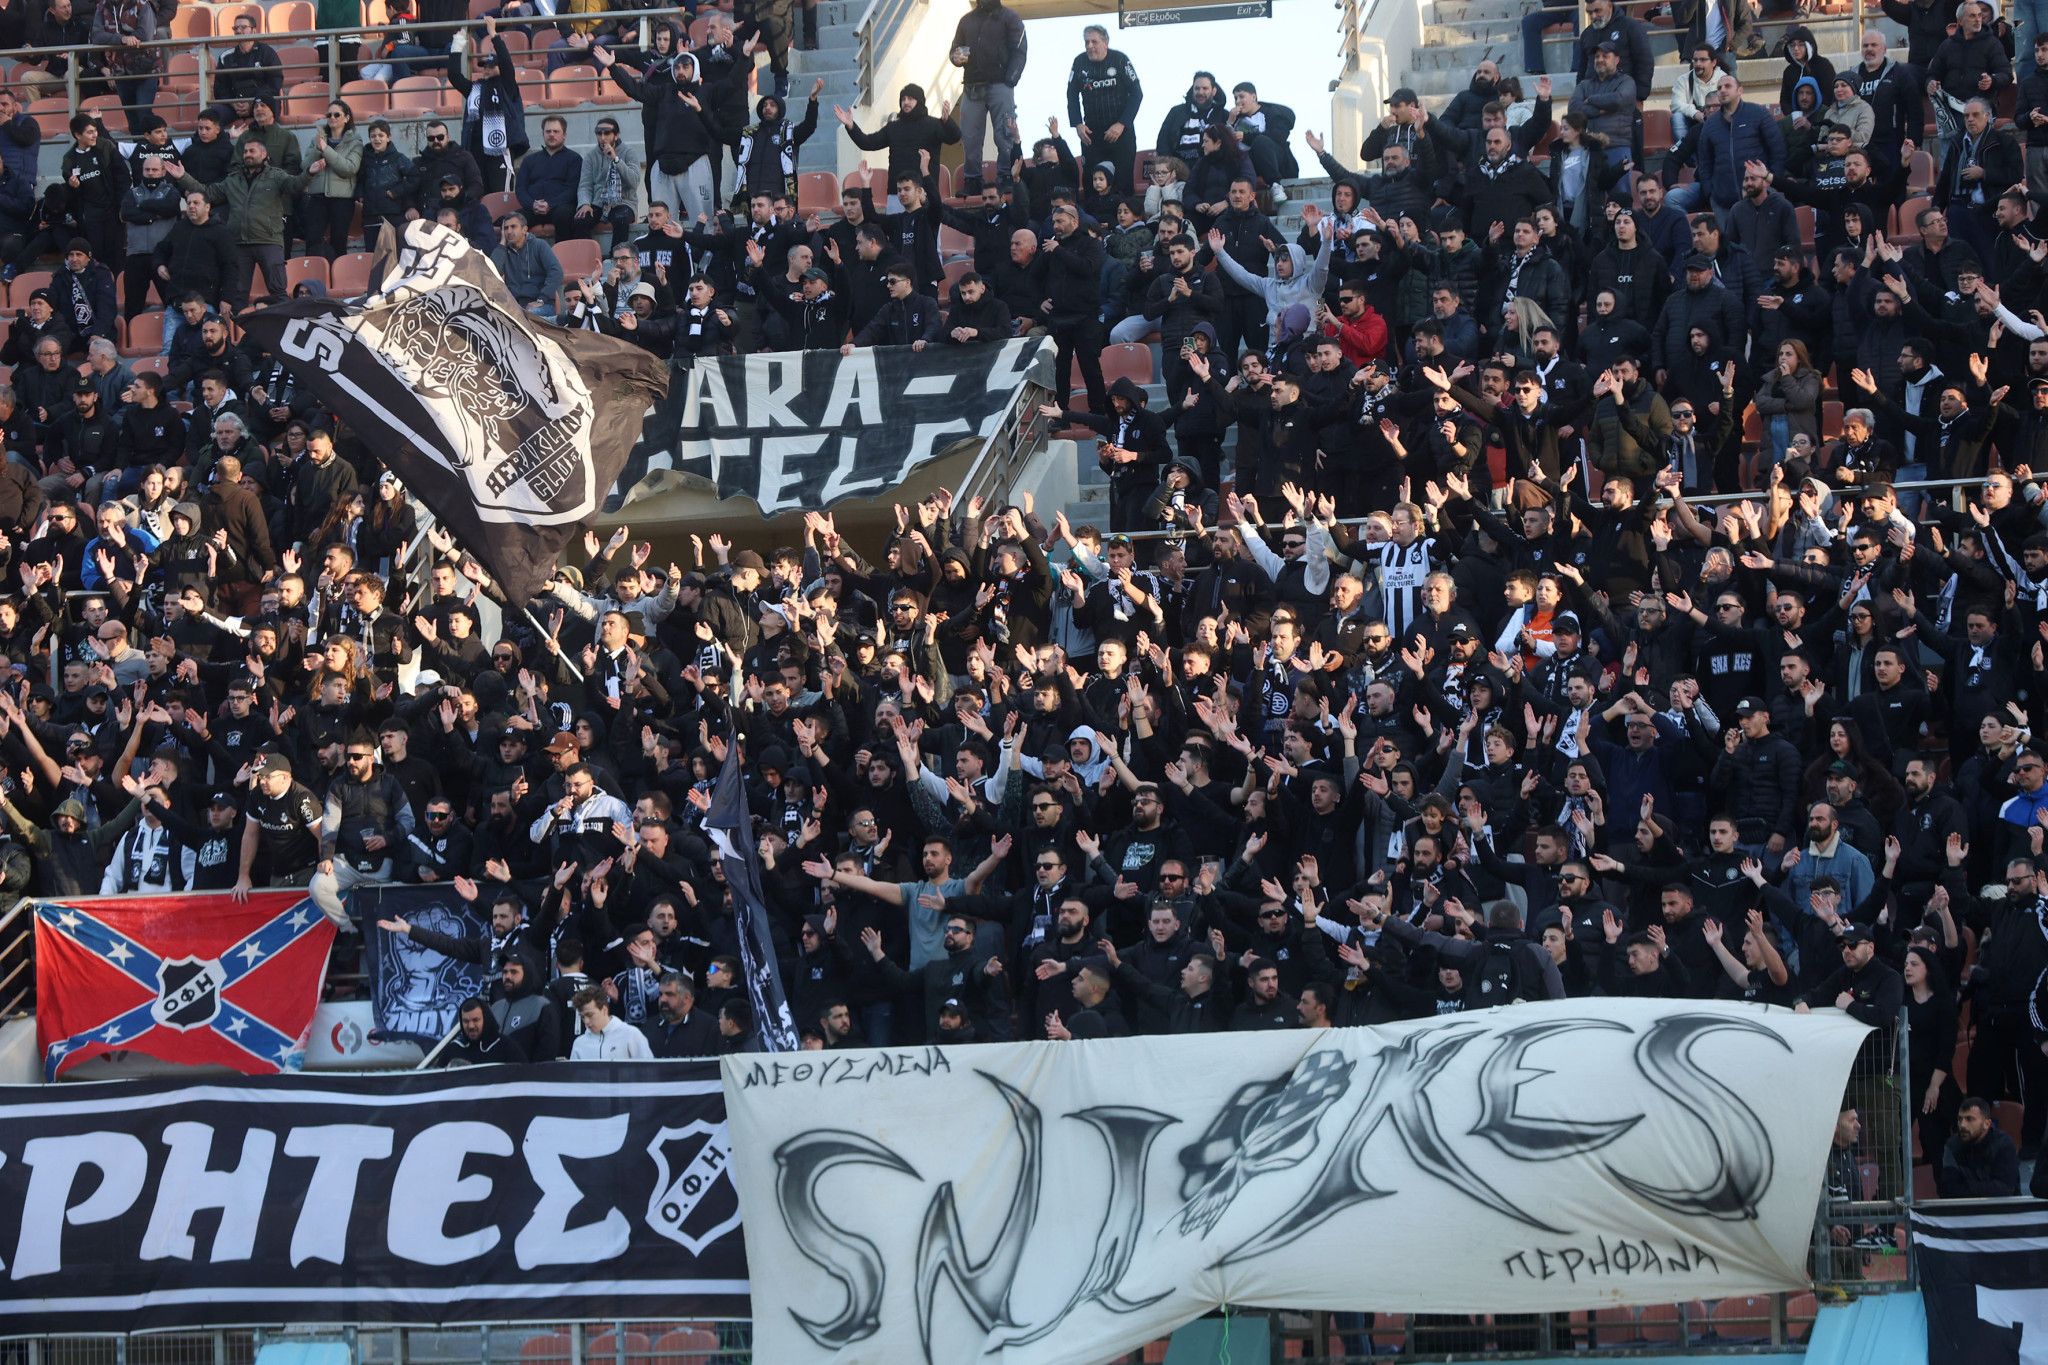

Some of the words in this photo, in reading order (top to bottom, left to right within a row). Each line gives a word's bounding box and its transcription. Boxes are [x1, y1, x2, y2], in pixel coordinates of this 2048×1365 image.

[1237, 7, 1252, 15] Exit
[1386, 580, 1416, 588] CULTURE
[1711, 654, 1729, 675] SNA
[1733, 652, 1752, 671] KES
[163, 972, 214, 1012] ΟΦΗ
[743, 1046, 951, 1090] ΜΕΘΥΣΜΕΝΑ
[0, 1112, 631, 1282] ΡΗΤΕΣ
[1503, 1234, 1721, 1284] ΠΕΡΗΦΑΝΑ
